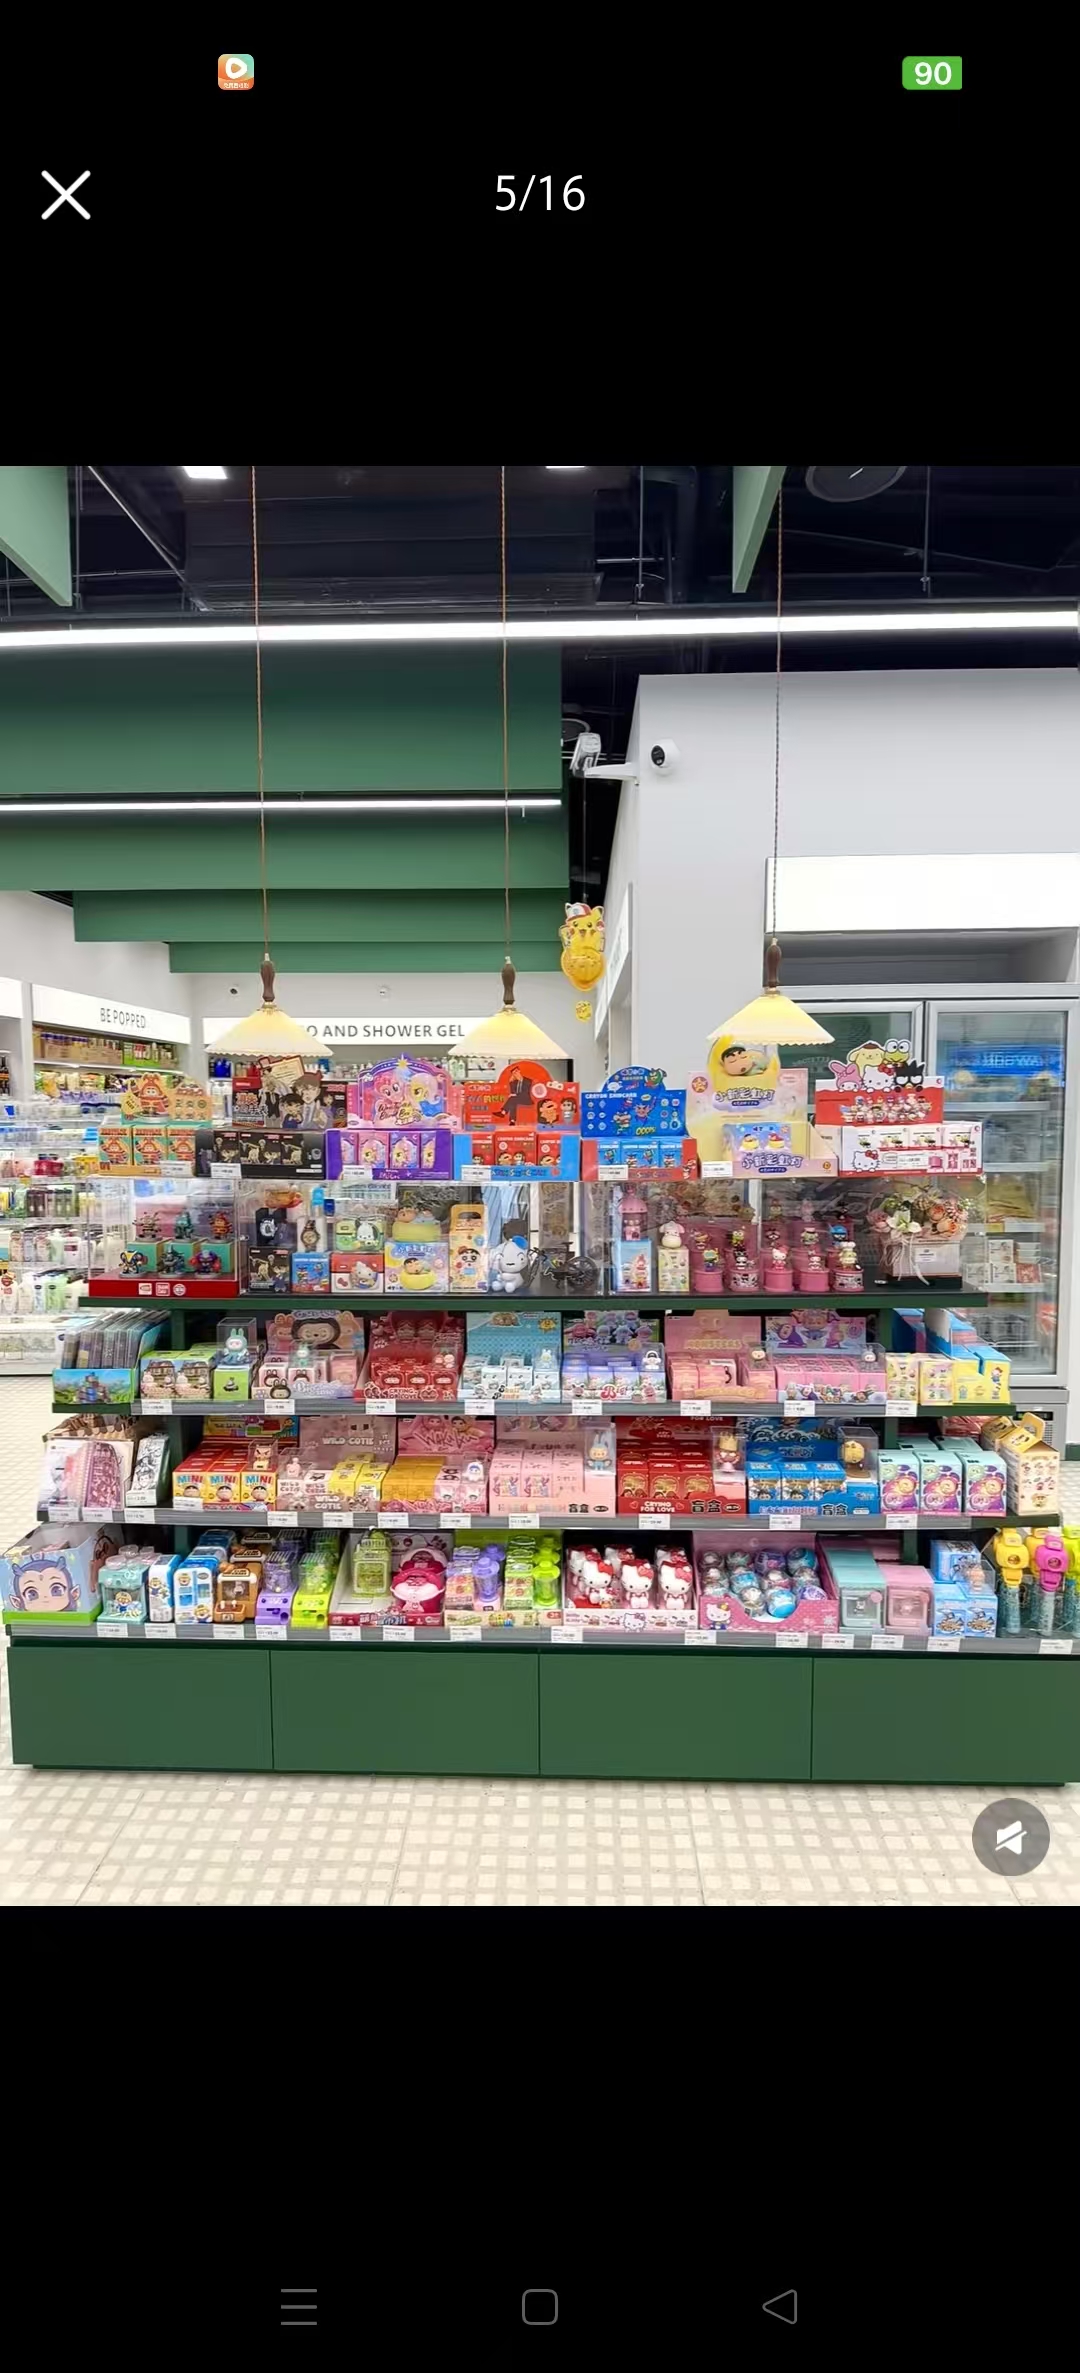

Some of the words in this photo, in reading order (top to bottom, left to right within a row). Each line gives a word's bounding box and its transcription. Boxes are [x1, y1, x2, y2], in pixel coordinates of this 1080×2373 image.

[100, 1007, 111, 1023] BE
[113, 1009, 146, 1029] POPPED
[322, 1024, 358, 1037] AND
[362, 1024, 433, 1037] SHOWER
[436, 1024, 465, 1037] GEL
[177, 1475, 204, 1484] MINI
[210, 1475, 236, 1484] MINI
[246, 1475, 272, 1484] MINI
[691, 1499, 722, 1514] 盲盒
[821, 1503, 848, 1516] 盲盒
